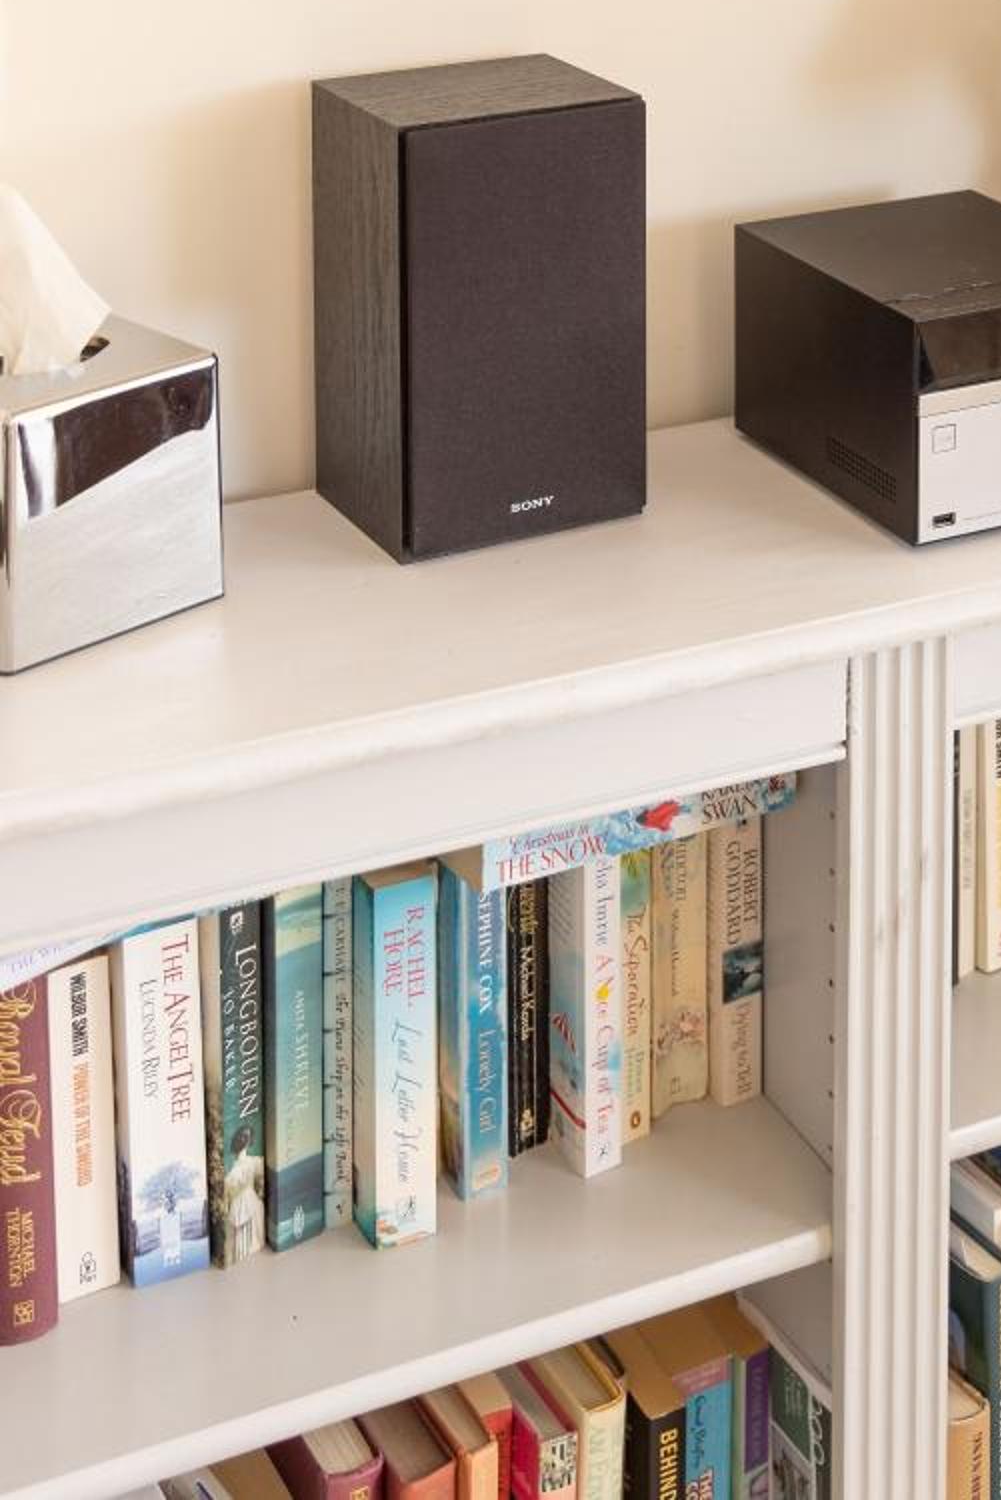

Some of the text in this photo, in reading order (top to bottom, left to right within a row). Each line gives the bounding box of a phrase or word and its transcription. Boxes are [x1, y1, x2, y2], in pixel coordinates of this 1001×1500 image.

[510, 494, 555, 514] SONY
[701, 794, 760, 826] SWAN
[496, 834, 607, 883] THE SNOW
[726, 839, 743, 947] GODDARD
[743, 848, 760, 924] ROBERT
[406, 905, 426, 1008] RACHEL
[478, 895, 495, 965] SEPHINE
[597, 954, 613, 973] A
[68, 971, 89, 1017] WILBUR
[478, 974, 494, 1015] COX
[519, 944, 537, 998] Michael
[0, 978, 39, 1086] Royal
[71, 1017, 90, 1058] SMITH
[138, 978, 162, 1102] LUCINDA RILEY
[161, 933, 195, 1125] THE ANGEL TREE
[222, 987, 237, 1094] JO BAKER
[234, 941, 259, 1120] LONGBOURN
[293, 1030, 310, 1110] SHREVE
[0, 1088, 43, 1187] Feud
[4, 1205, 24, 1288] THORNTON
[20, 1209, 36, 1277] MICHAEL
